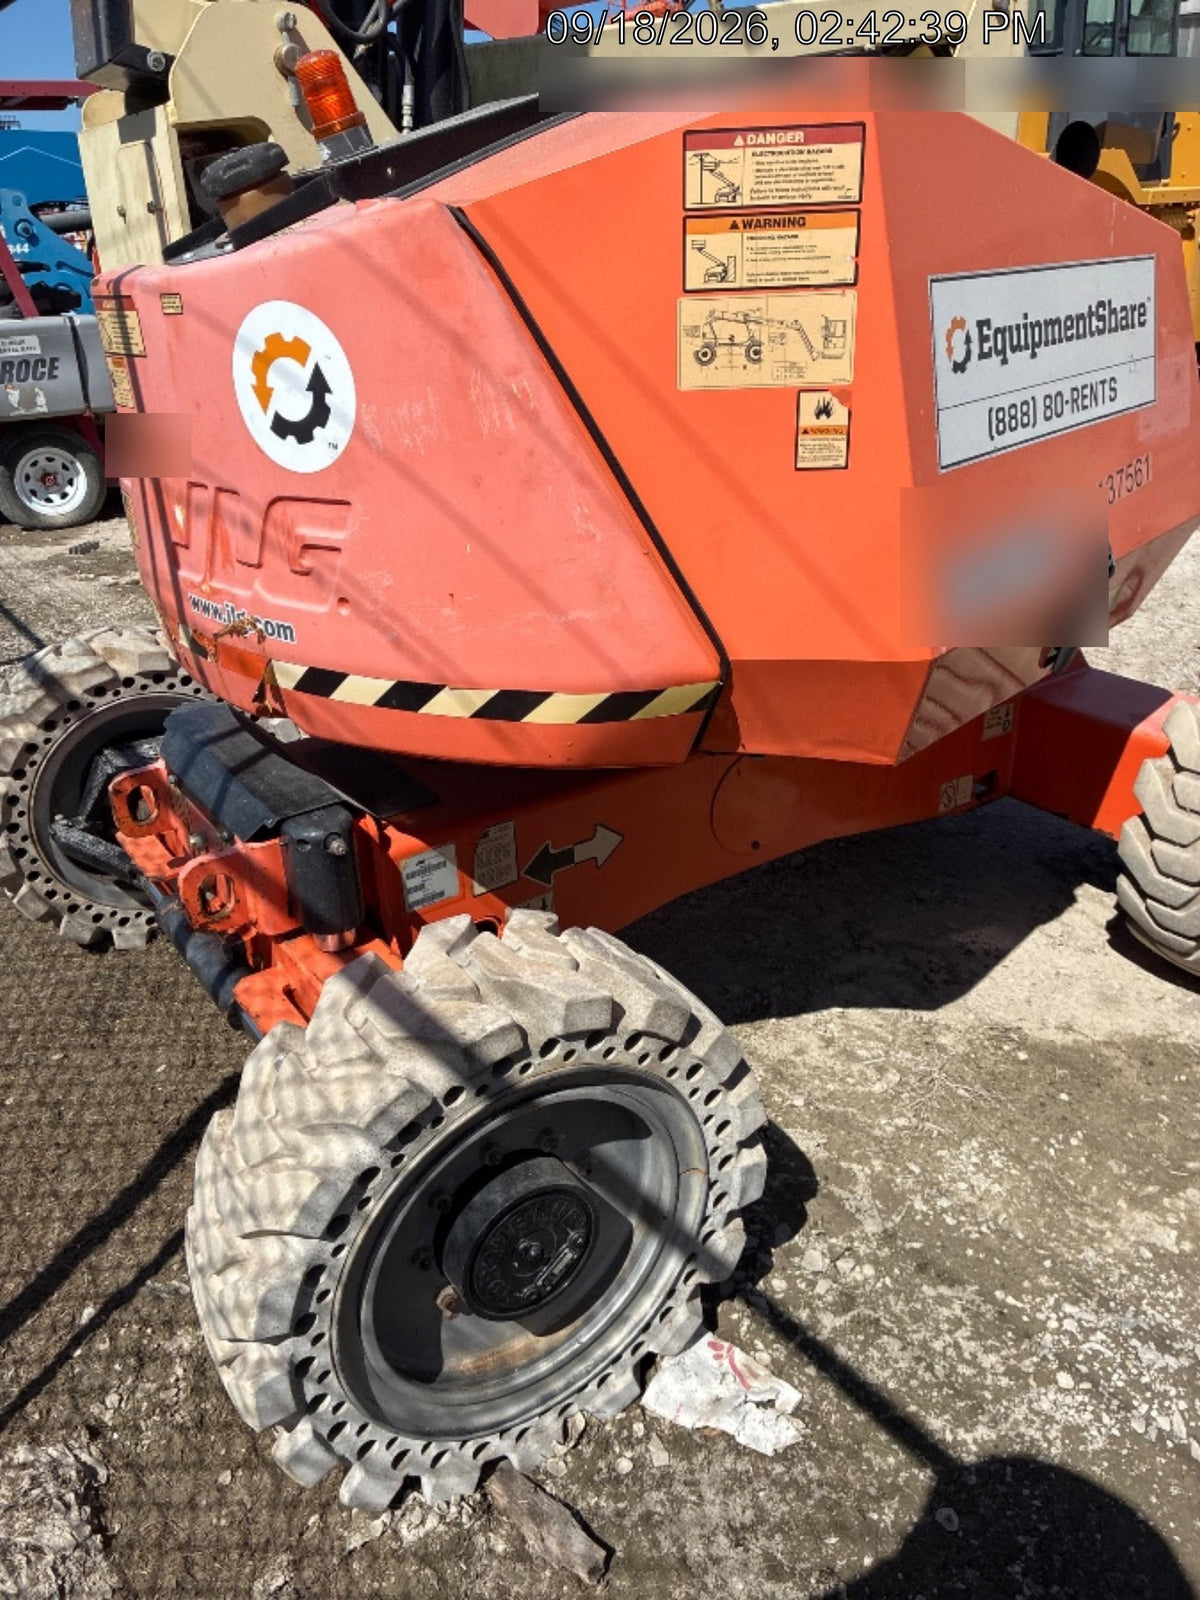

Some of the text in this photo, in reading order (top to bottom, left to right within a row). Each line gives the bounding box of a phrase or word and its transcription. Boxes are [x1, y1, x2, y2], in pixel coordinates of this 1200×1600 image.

[746, 131, 805, 145] DANGER
[741, 216, 807, 230] WARNING
[975, 298, 1148, 366] EquipmentShare
[987, 376, 1118, 441] (888) 80-RENTS
[1098, 453, 1150, 505] 37561
